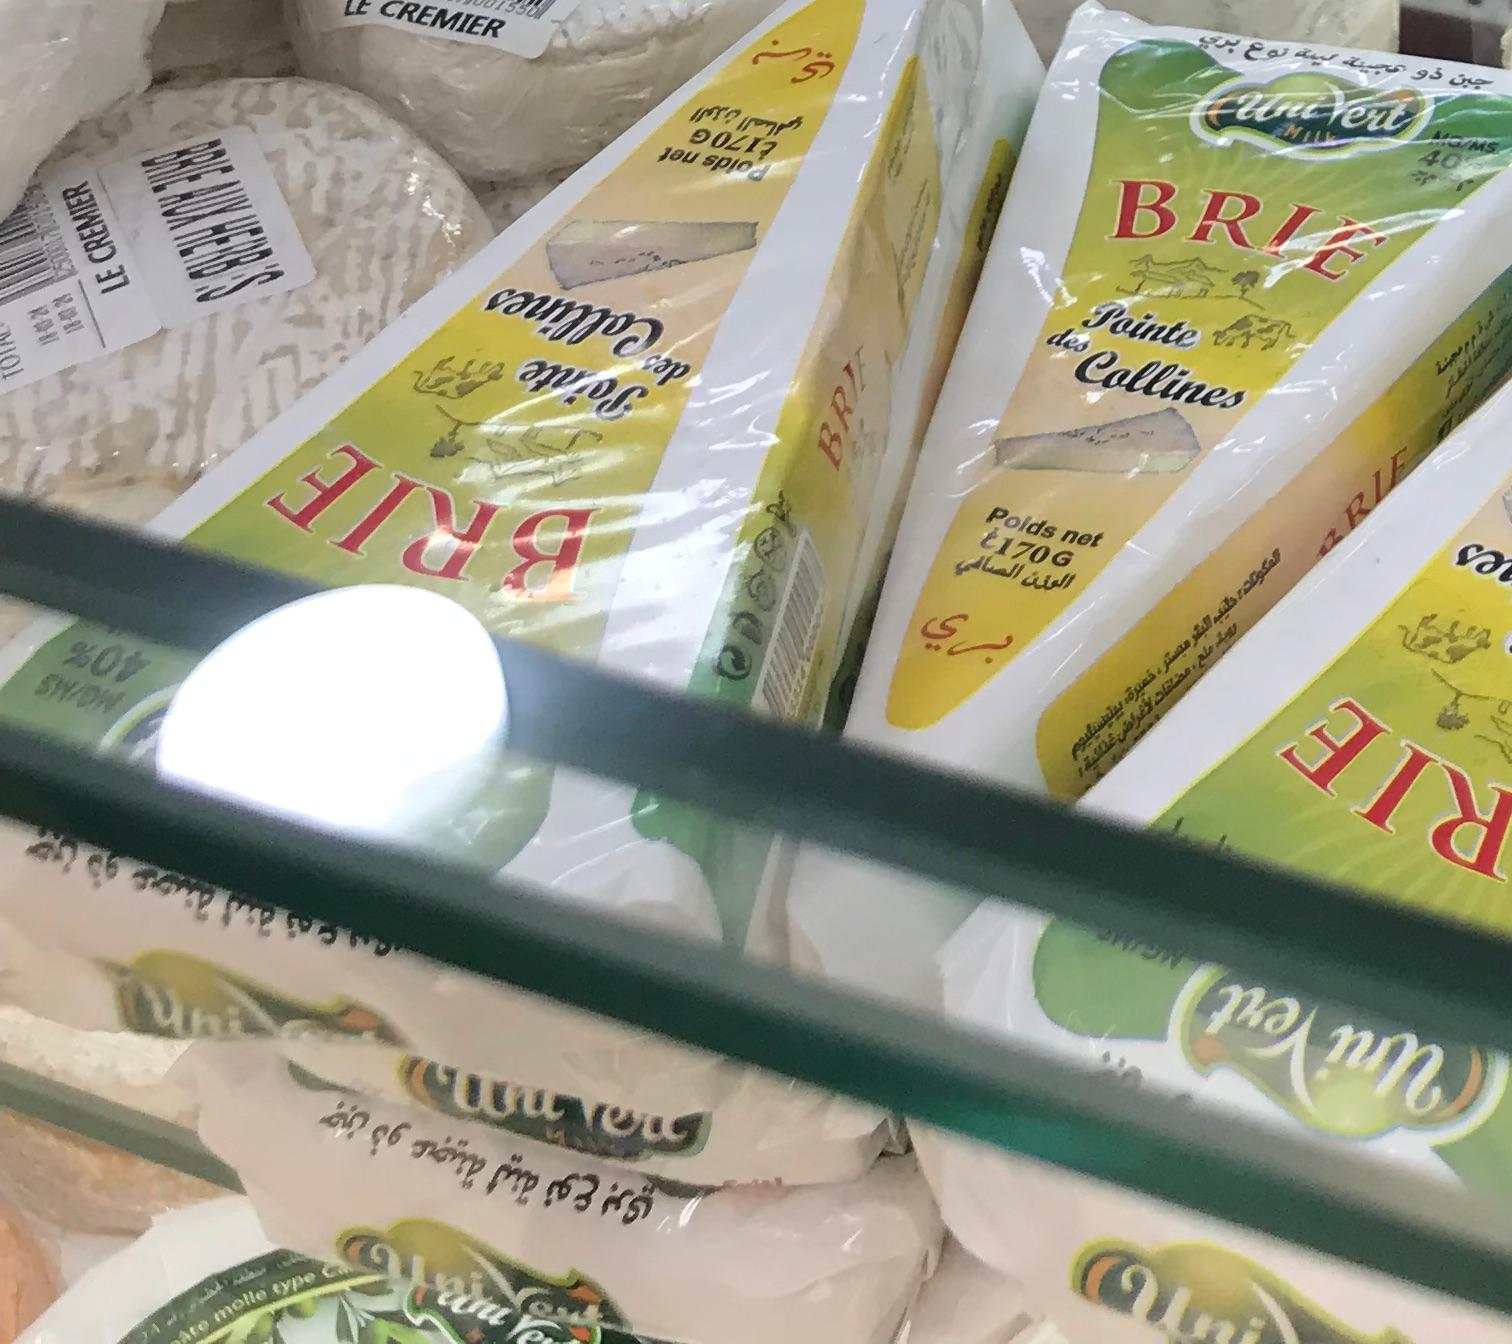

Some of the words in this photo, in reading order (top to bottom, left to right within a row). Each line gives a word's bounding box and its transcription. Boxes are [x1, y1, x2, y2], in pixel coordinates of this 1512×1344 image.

[379, 0, 506, 39] CREMIER
[140, 138, 236, 193] BRIE
[657, 144, 699, 166] net
[62, 180, 118, 265] CREMIER
[156, 179, 253, 232] AUX
[1107, 178, 1390, 283] BRIE
[95, 263, 131, 295] LE
[485, 286, 666, 358] Collines
[1080, 300, 1200, 352] Pointe
[519, 358, 651, 422] Pointe
[645, 352, 691, 386] des
[1046, 326, 1090, 354] des
[1073, 350, 1248, 411] Collines
[267, 443, 601, 603] BRIE
[1060, 525, 1105, 549] net
